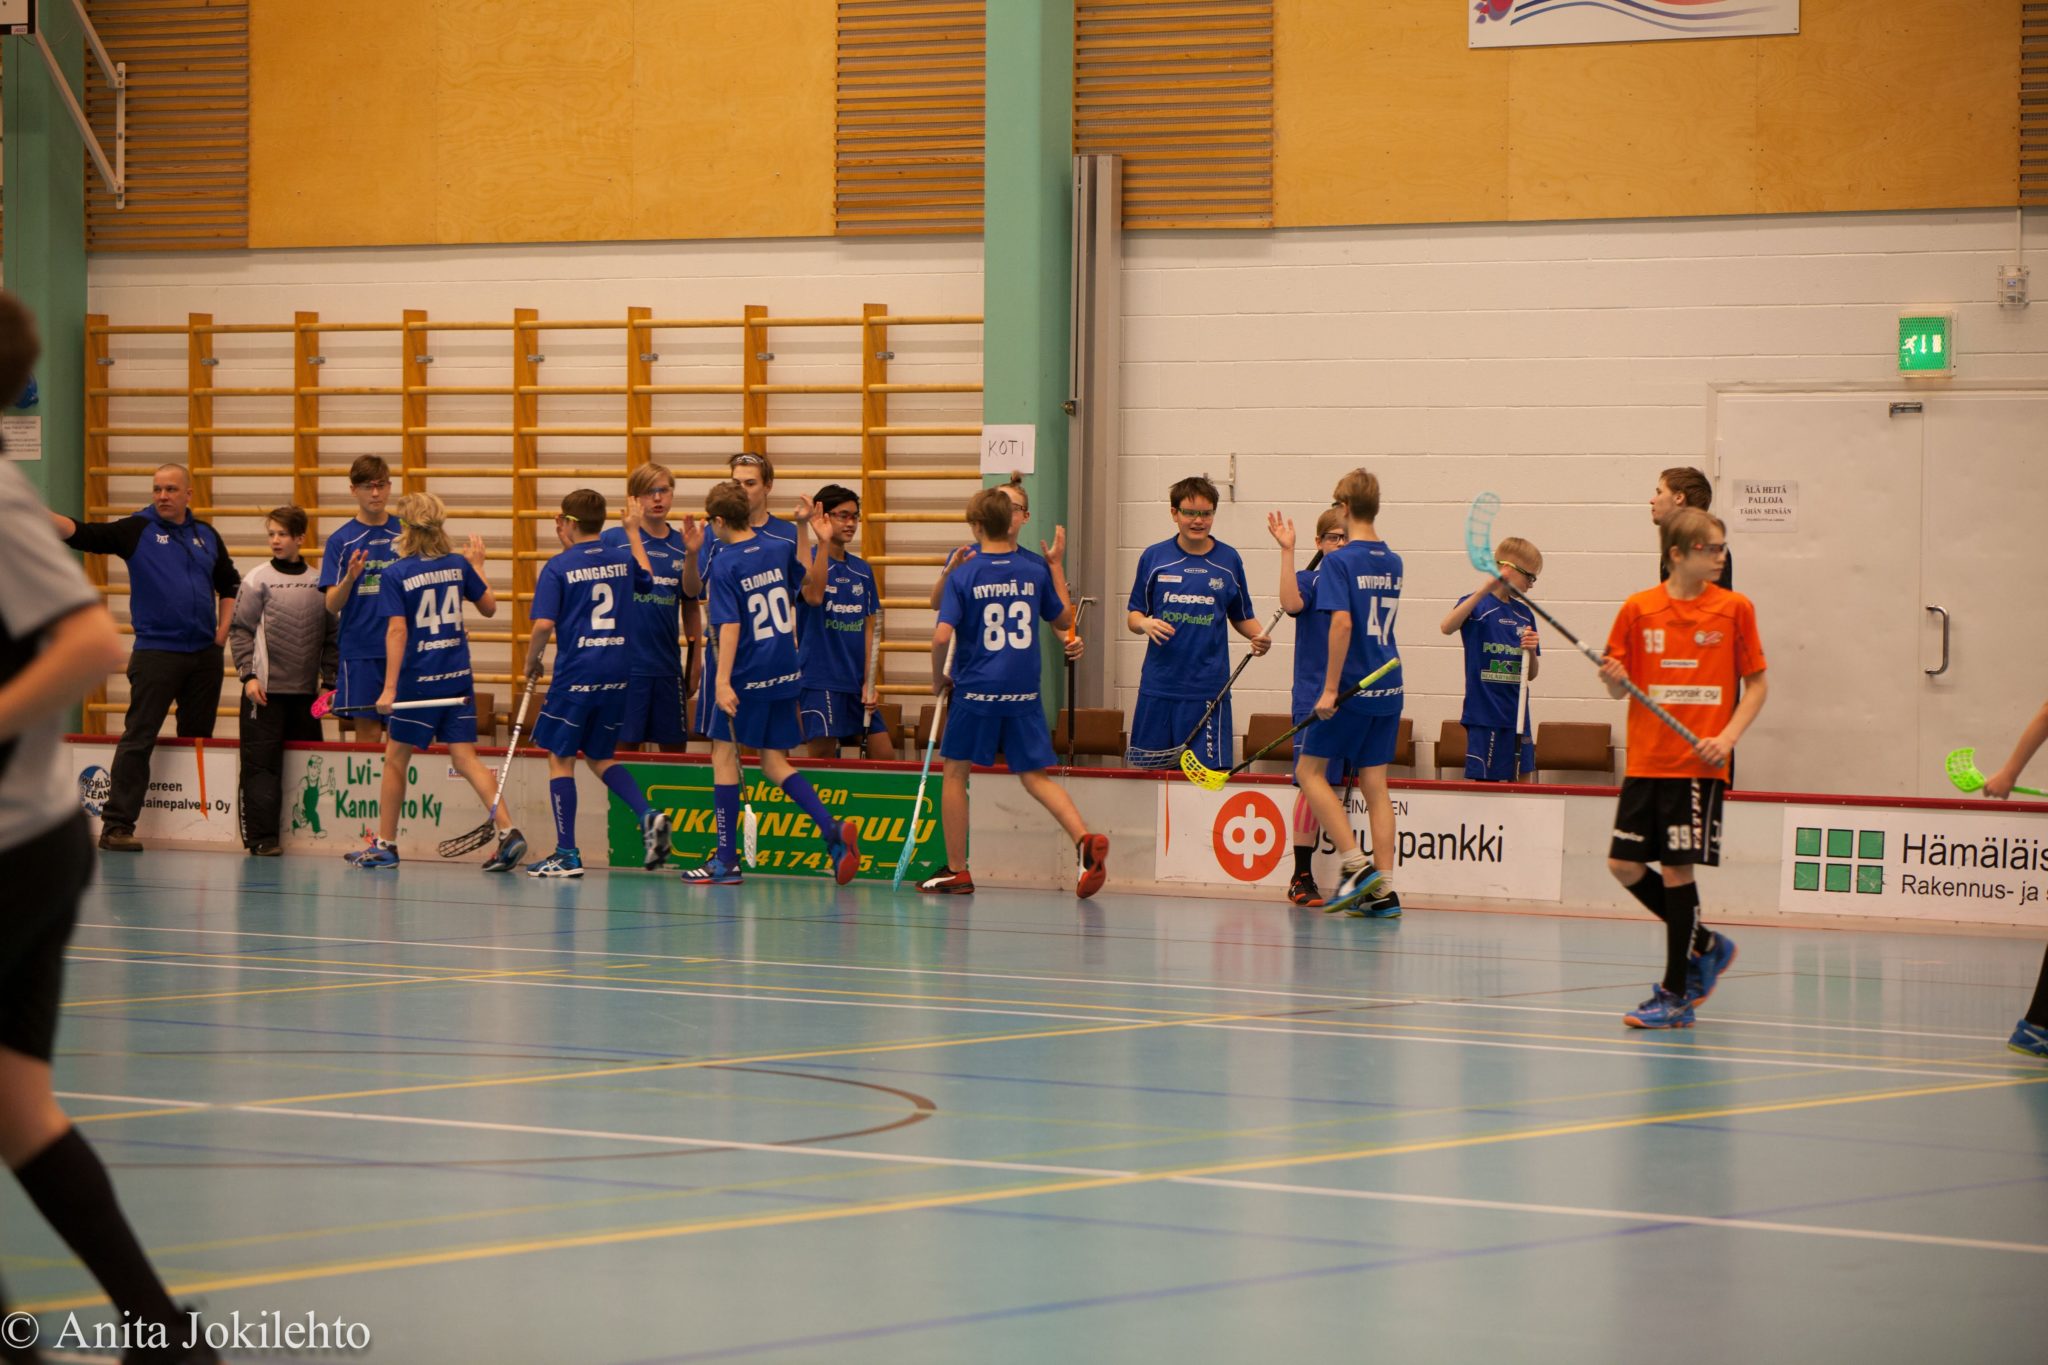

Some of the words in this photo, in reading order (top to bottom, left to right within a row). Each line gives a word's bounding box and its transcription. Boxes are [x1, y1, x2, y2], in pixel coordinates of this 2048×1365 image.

[988, 439, 1024, 457] KOTI
[1744, 485, 1761, 494] ÄLÄ
[1762, 484, 1787, 494] HEITÄ
[1748, 496, 1784, 504] PALLOJA
[1740, 507, 1762, 515] TÄHÄN
[1764, 507, 1792, 515] SEINÄÄN
[740, 568, 784, 592] ELOMAA
[973, 579, 1019, 599] HYYPPÄ
[1021, 582, 1035, 596] JO
[1357, 573, 1392, 590] HYYPPÄ
[1394, 576, 1403, 590] J
[415, 585, 462, 635] 44
[591, 582, 616, 630] 2
[747, 586, 793, 642] 20
[983, 601, 1033, 651] 83
[1367, 596, 1400, 646] 47
[568, 684, 601, 692] FAT
[600, 682, 628, 691] PIP
[744, 679, 779, 690] FAT
[777, 672, 803, 684] PIP
[963, 692, 999, 701] FAT
[998, 692, 1039, 702] PIPE
[84, 788, 110, 800] LEAN
[147, 781, 182, 792] ereen
[739, 781, 849, 806] akeen
[215, 800, 231, 814] Oy
[422, 793, 442, 826] Ky
[717, 807, 726, 829] PIPE
[718, 830, 727, 848] FAT
[1901, 874, 2014, 900] Rakennus-
[2019, 881, 2038, 906] ja
